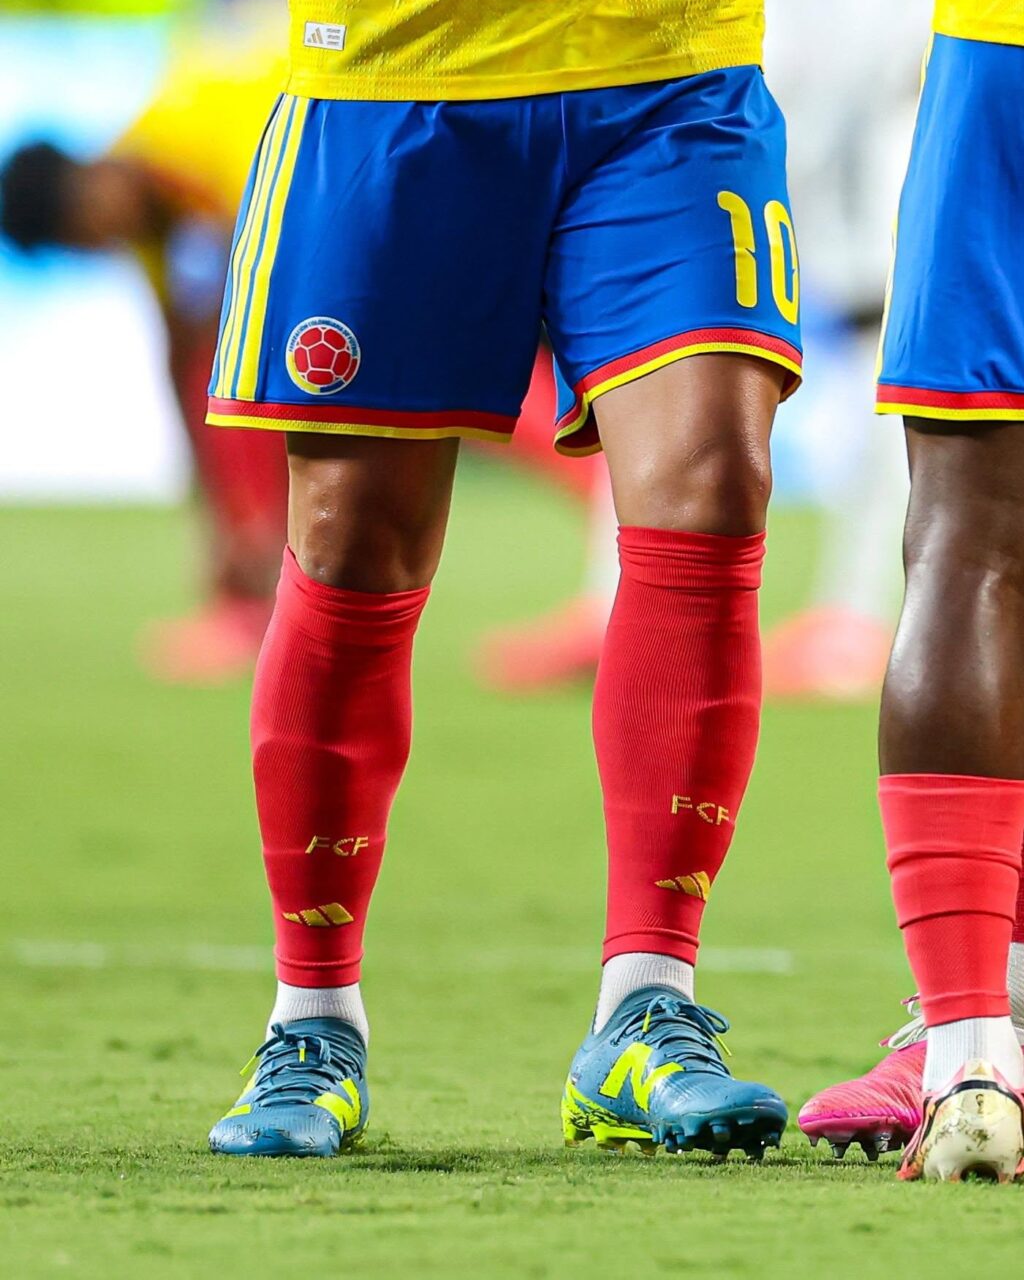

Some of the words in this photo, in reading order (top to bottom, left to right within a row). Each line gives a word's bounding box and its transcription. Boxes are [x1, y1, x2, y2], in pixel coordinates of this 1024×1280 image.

[717, 190, 800, 326] 10
[671, 793, 730, 826] FCF
[305, 835, 369, 857] FCF
